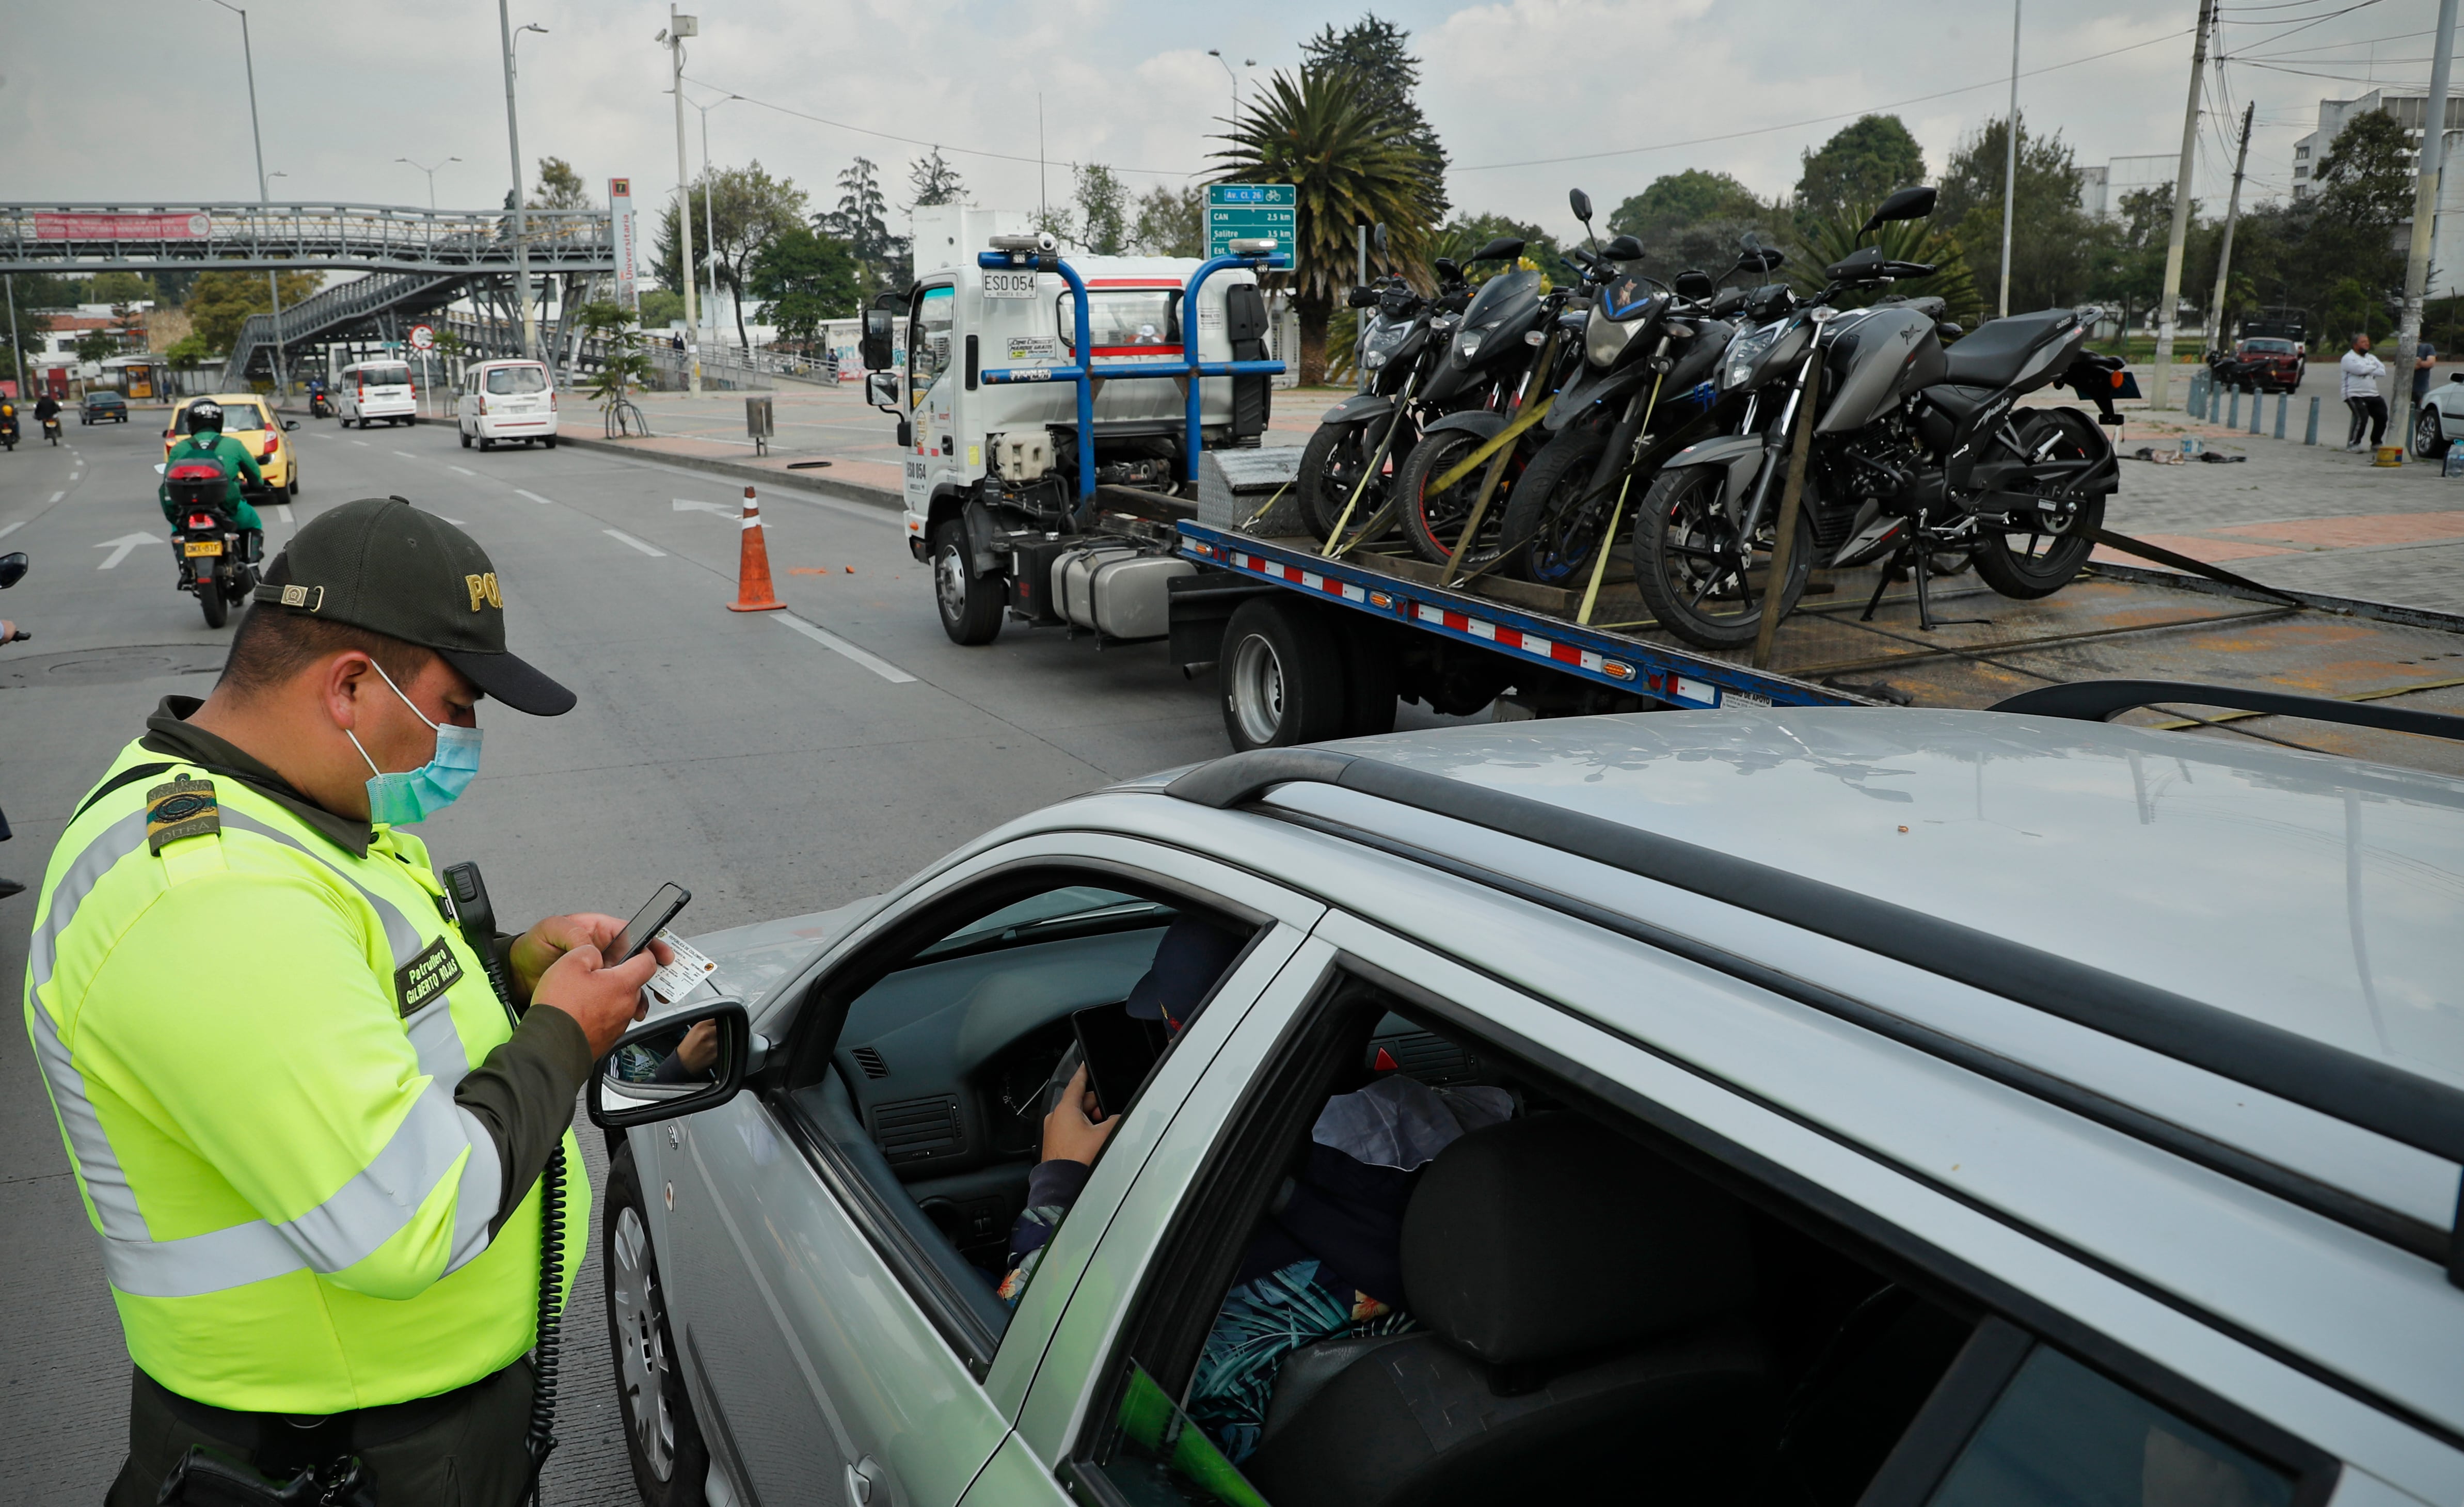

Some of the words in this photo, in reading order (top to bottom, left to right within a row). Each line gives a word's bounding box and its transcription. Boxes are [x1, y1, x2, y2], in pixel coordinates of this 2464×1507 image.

[622, 214, 633, 280] Universitaria
[984, 275, 1008, 290] ESO
[1012, 276, 1035, 291] 054
[1752, 692, 1770, 704] APOYO
[149, 785, 211, 802] NACIONAL
[162, 821, 210, 843] DITRA
[409, 949, 447, 985] Patrullero
[406, 973, 439, 1005] GILBERTO
[438, 958, 458, 982] ROJAS
